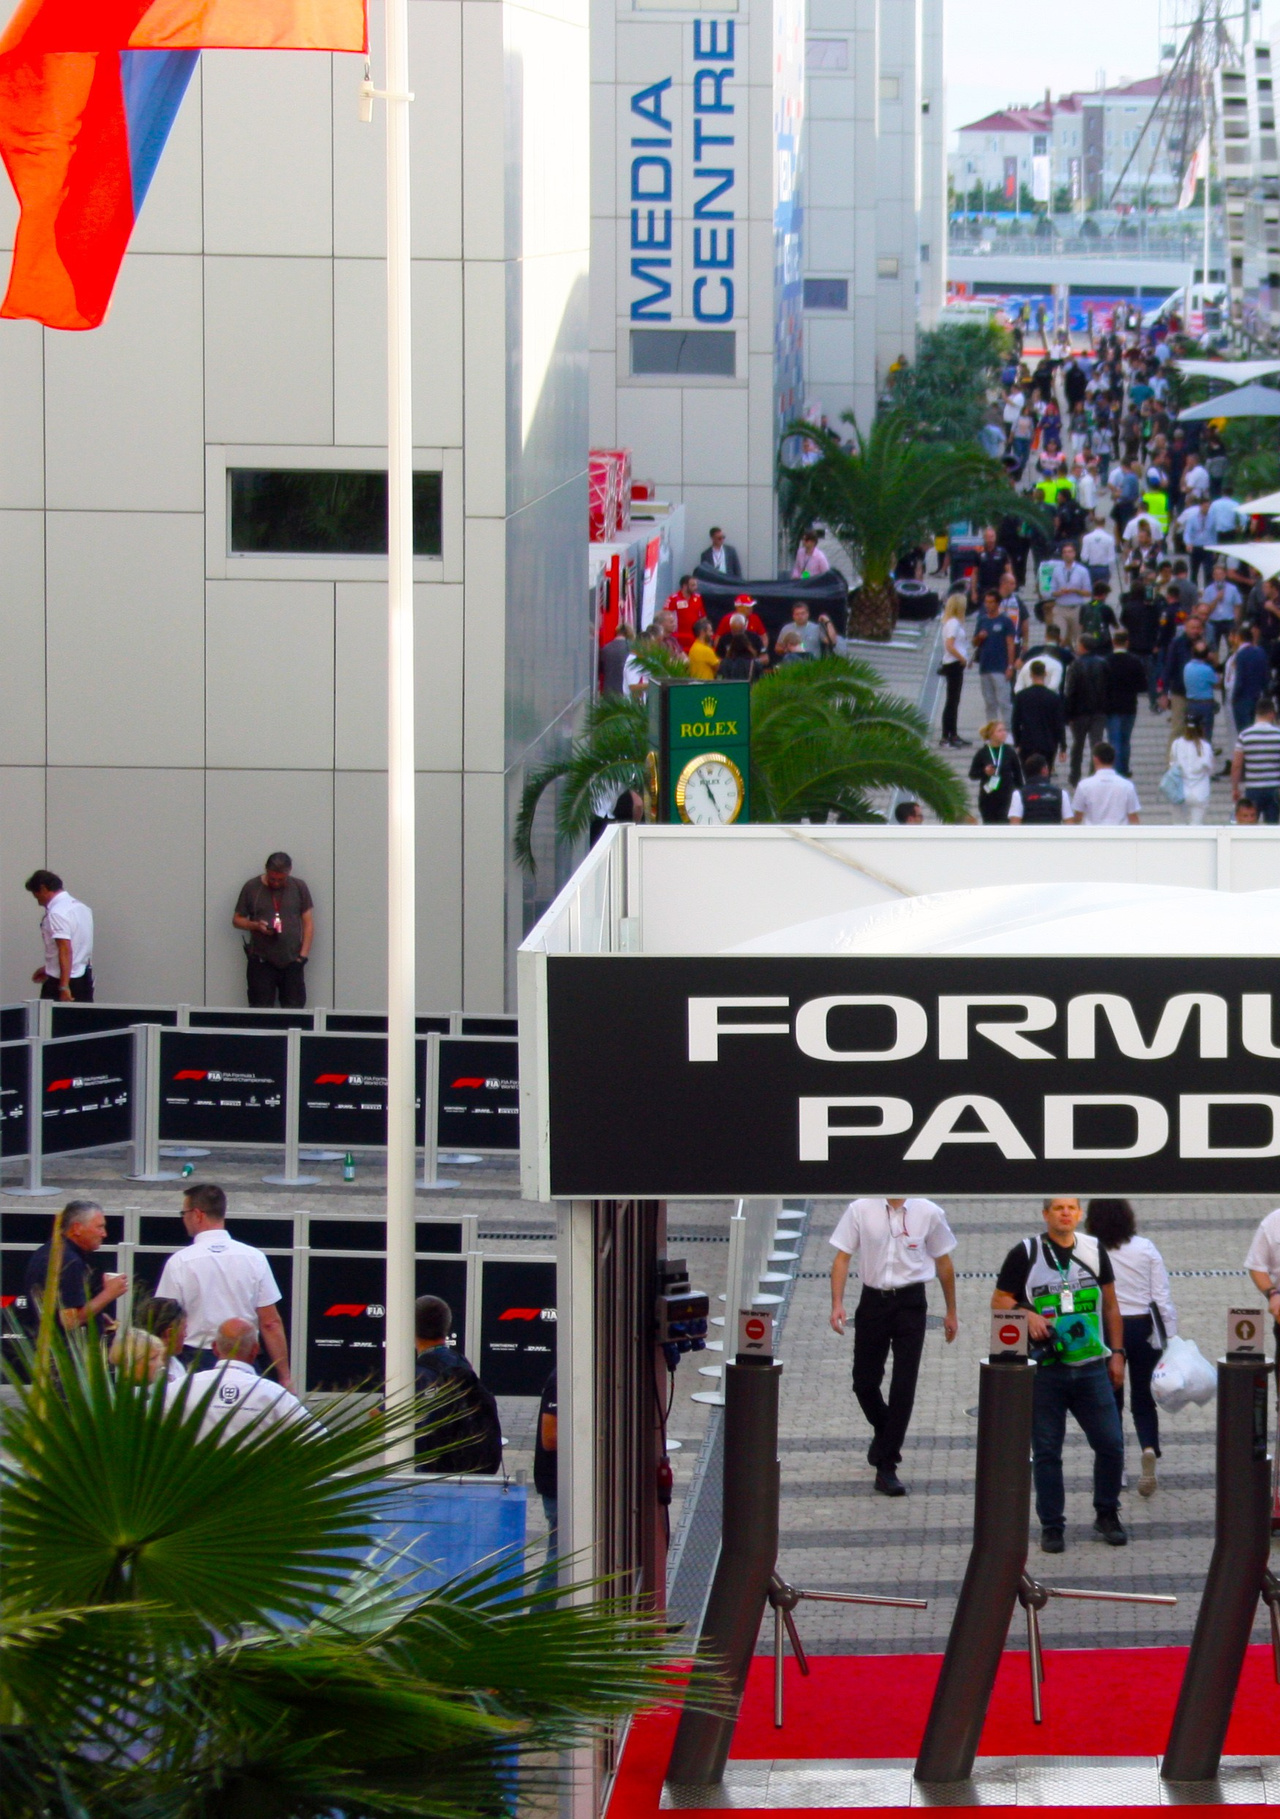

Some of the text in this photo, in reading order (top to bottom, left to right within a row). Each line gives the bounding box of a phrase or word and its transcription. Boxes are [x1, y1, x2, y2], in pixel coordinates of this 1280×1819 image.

[693, 19, 734, 324] CENTRE
[631, 76, 672, 322] MEDIA
[681, 721, 738, 737] ROLEX
[207, 1072, 221, 1081] FIA
[348, 1075, 362, 1084] FIA
[485, 1079, 499, 1089] FIA
[366, 1306, 384, 1316] FIA
[541, 1310, 558, 1320] FIA
